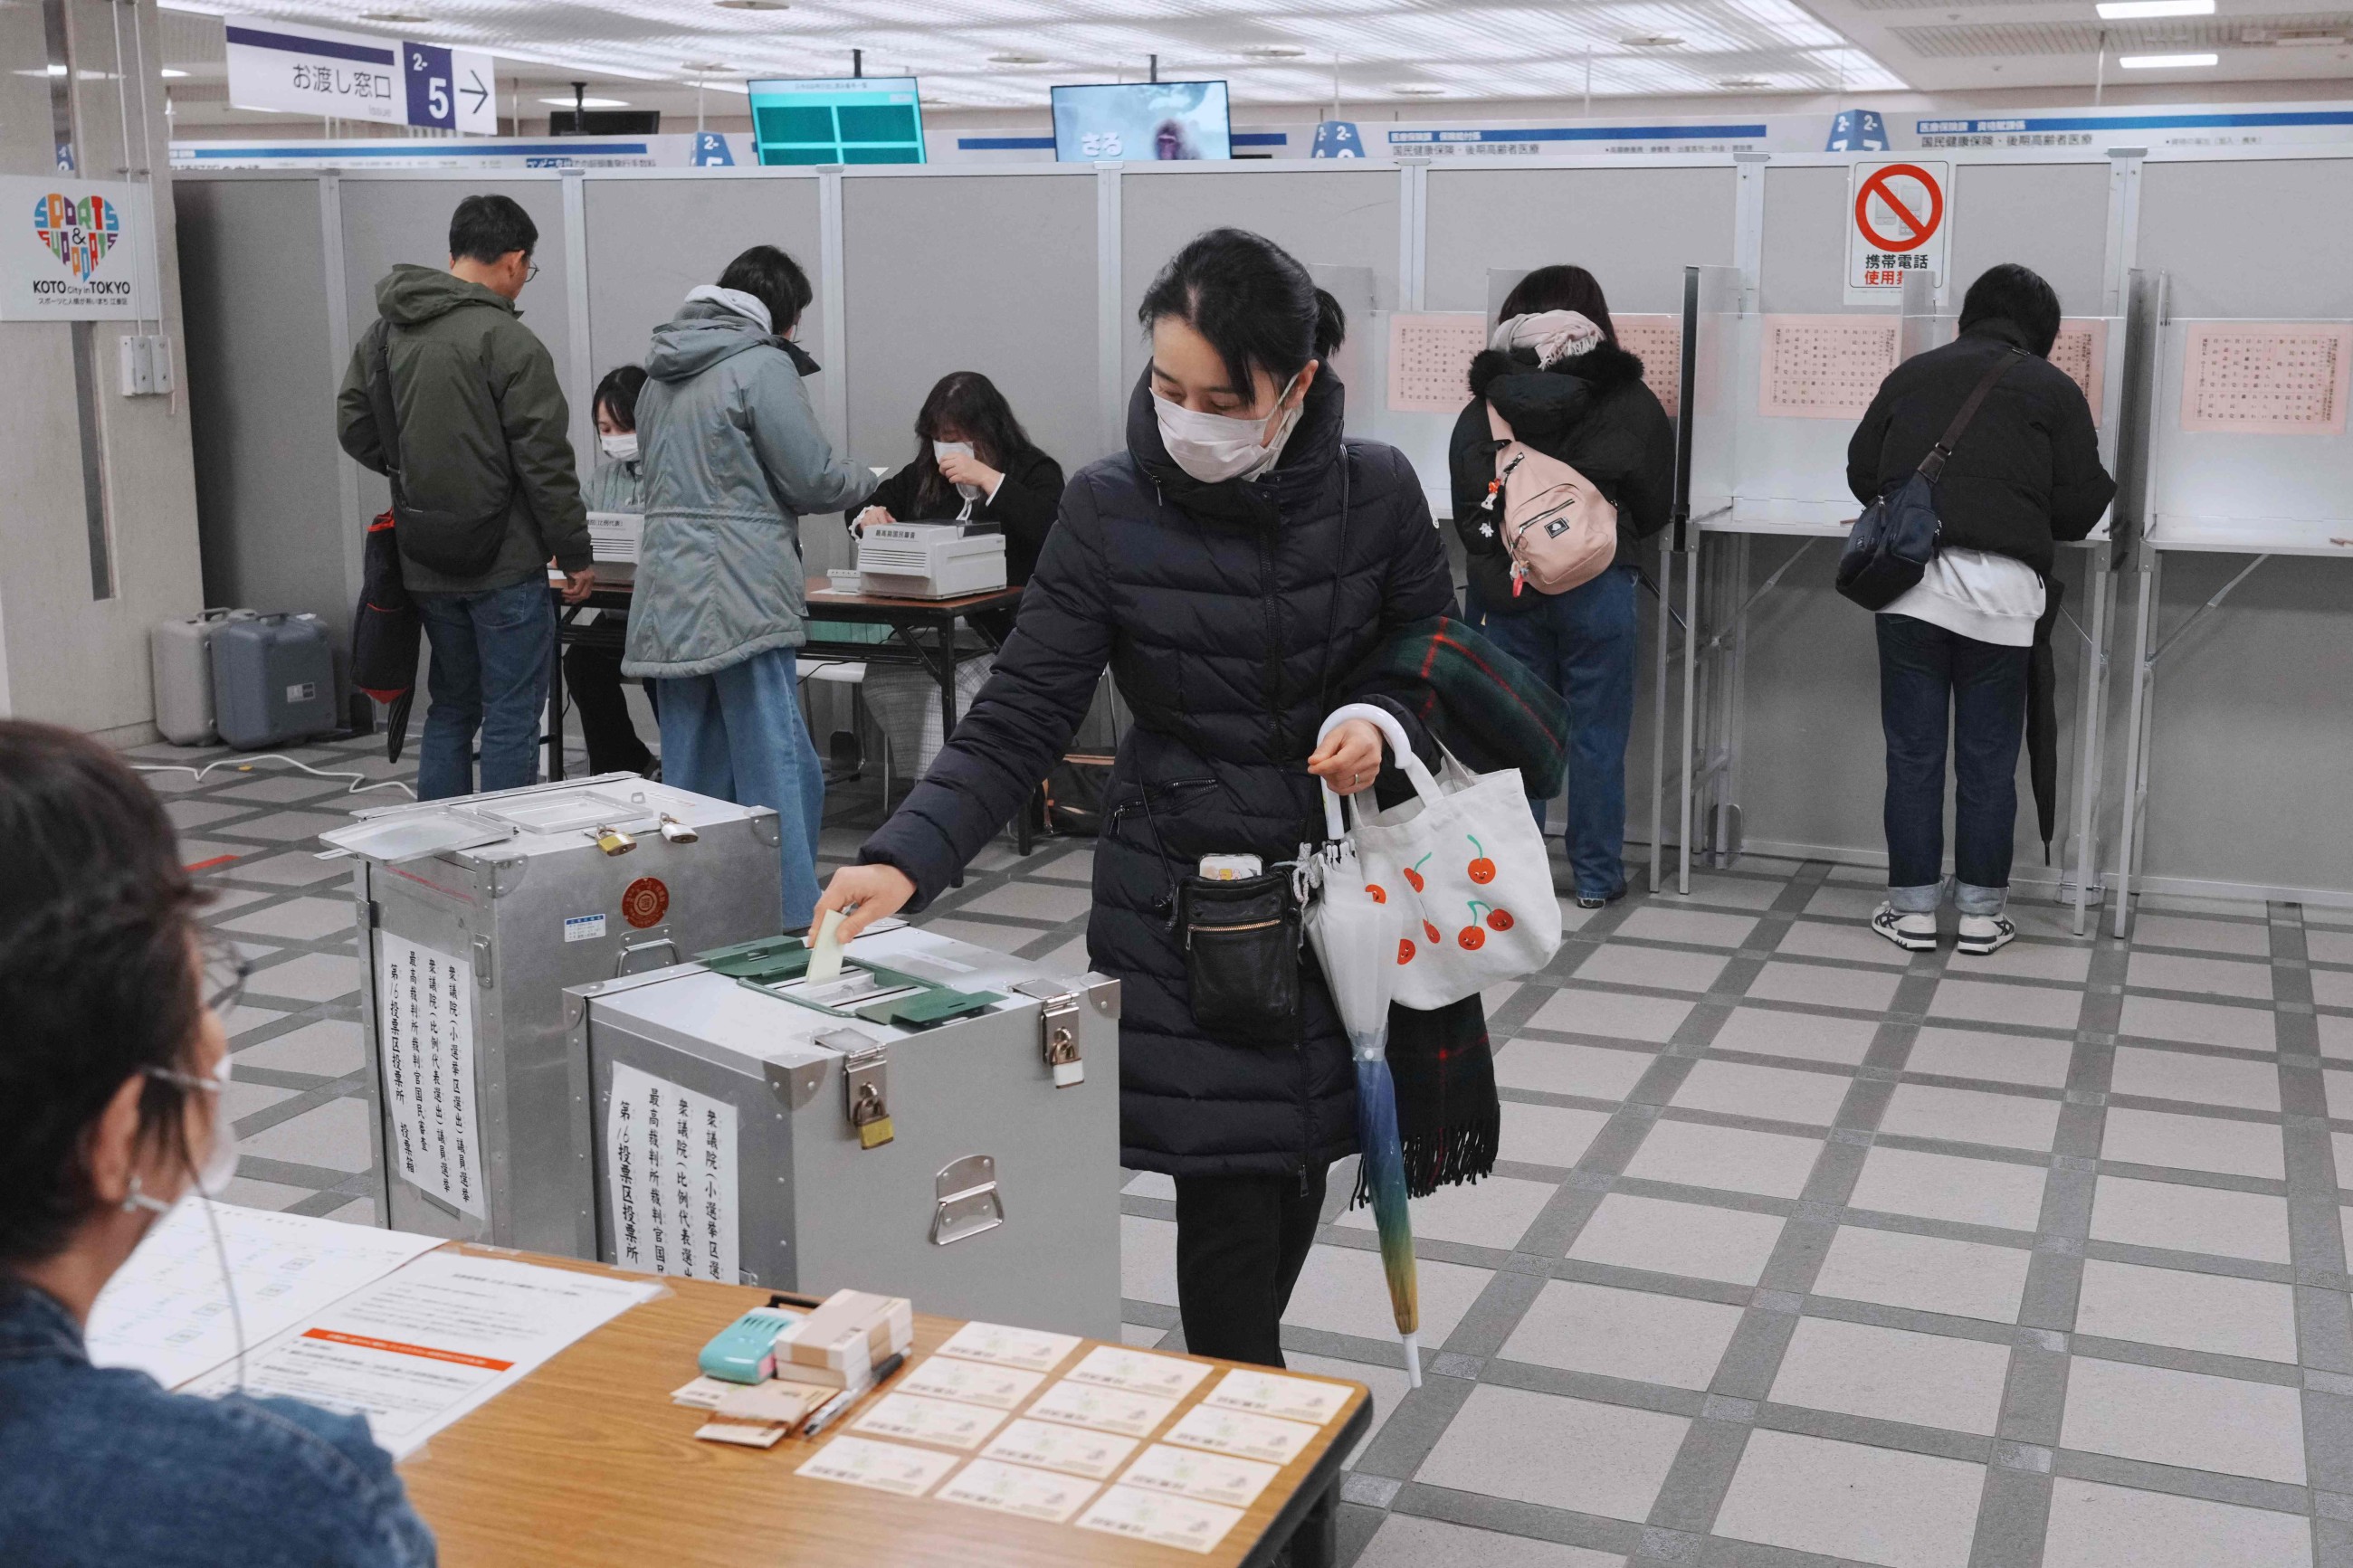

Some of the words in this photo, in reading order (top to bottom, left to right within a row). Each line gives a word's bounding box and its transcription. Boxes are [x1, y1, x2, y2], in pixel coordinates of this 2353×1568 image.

[292, 64, 391, 100] お渡し窓口
[1081, 131, 1122, 157] さる
[34, 194, 119, 232] SPORTS
[72, 227, 87, 245] &
[37, 230, 119, 283] SUPPORTS
[1865, 254, 1929, 270] 携帯電話
[33, 280, 67, 294] KOTO
[67, 286, 83, 296] City
[90, 280, 131, 295] TOKYO
